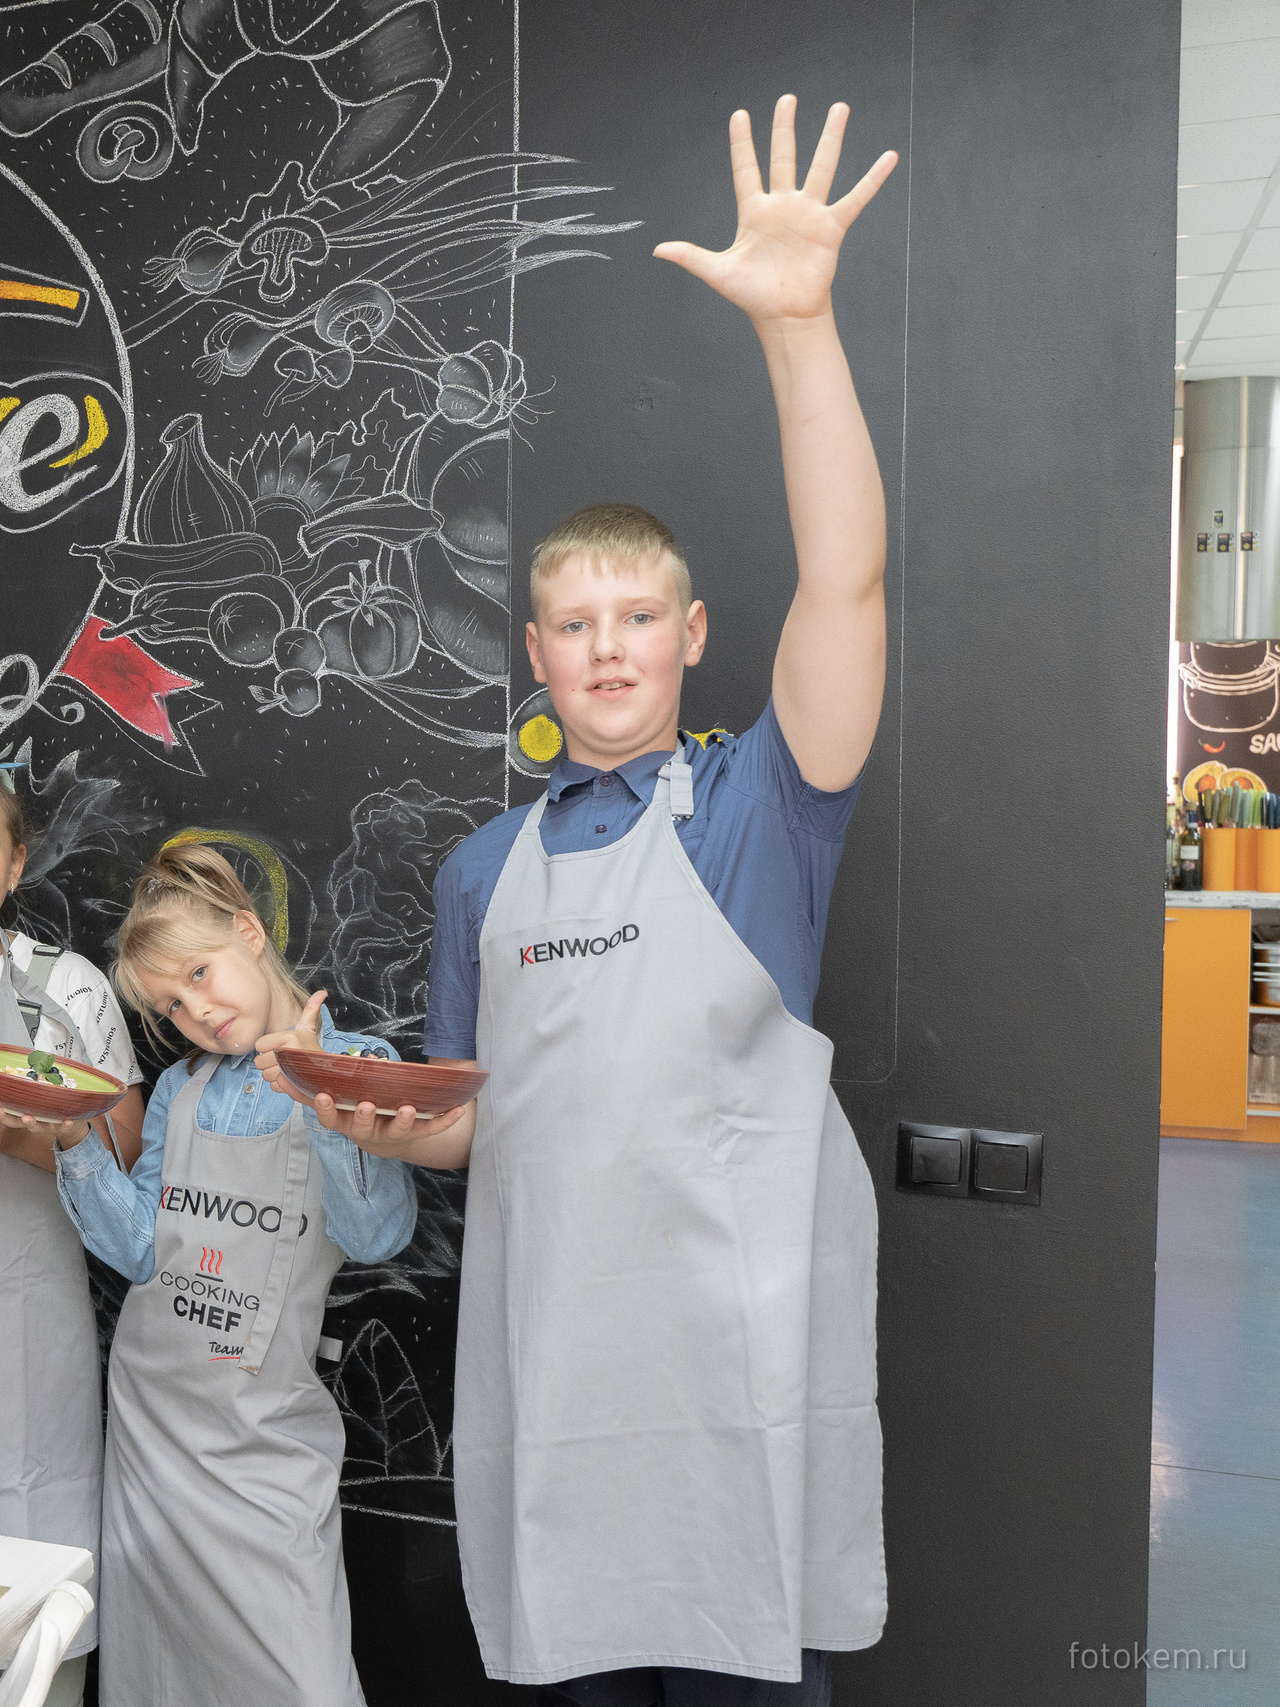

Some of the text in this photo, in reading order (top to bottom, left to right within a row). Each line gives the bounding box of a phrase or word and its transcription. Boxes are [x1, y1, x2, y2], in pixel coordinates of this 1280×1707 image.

[1249, 733, 1280, 755] SA
[519, 923, 640, 968] KENWOOD
[160, 1271, 261, 1312] COOKING
[173, 1295, 242, 1333] CHEF
[208, 1341, 245, 1355] Team
